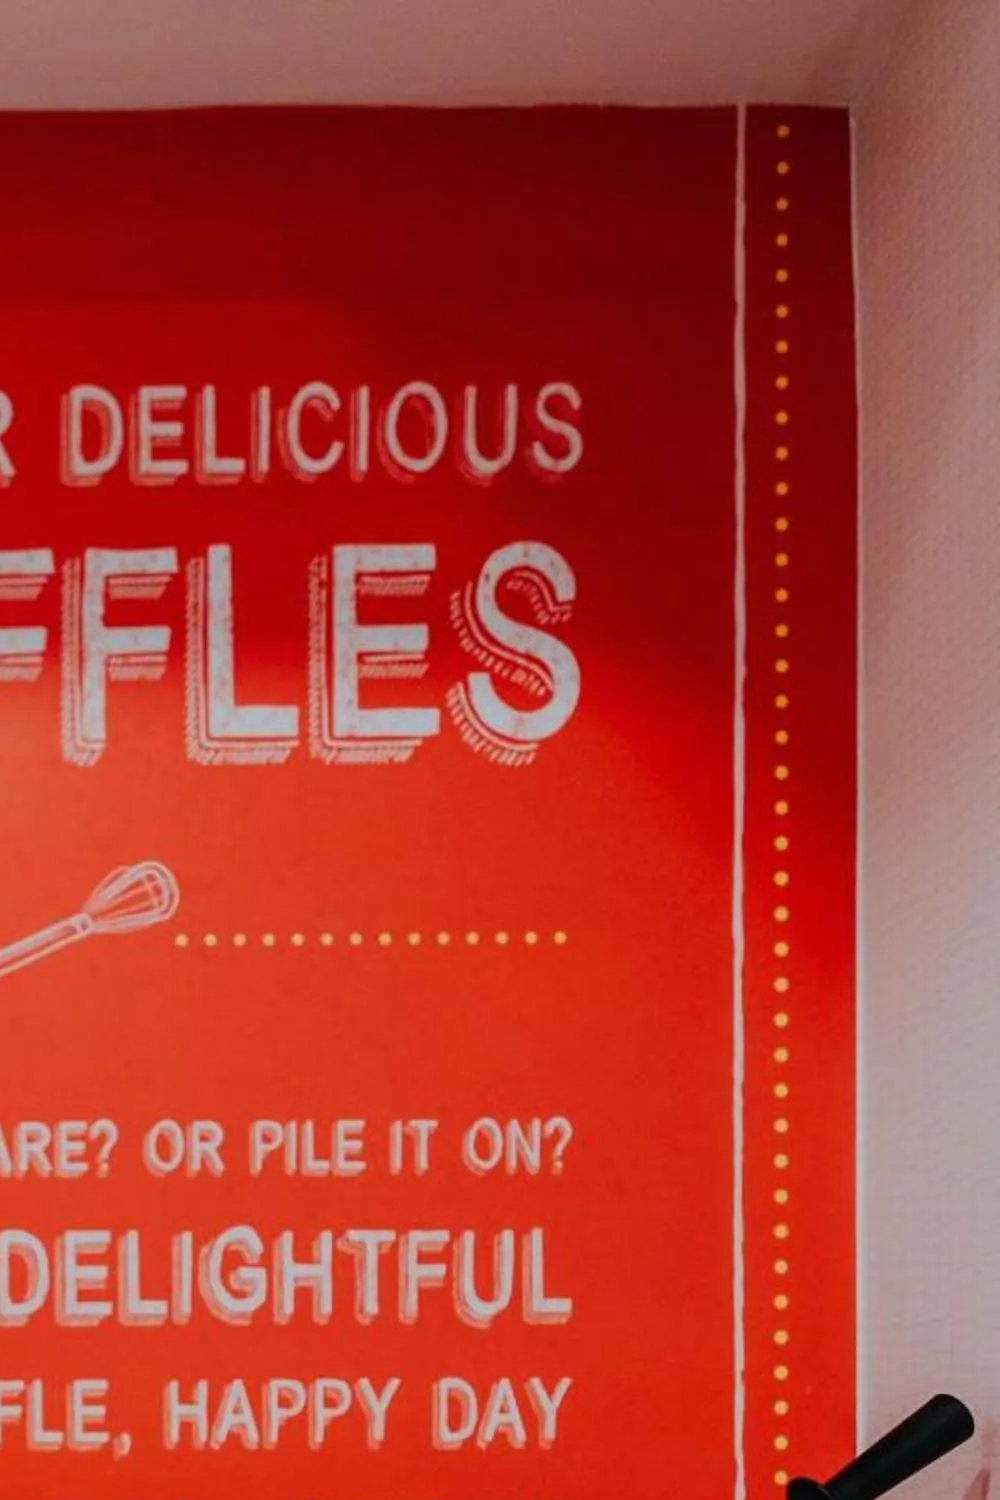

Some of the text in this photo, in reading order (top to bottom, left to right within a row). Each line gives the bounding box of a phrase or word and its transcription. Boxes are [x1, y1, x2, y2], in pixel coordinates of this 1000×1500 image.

[60, 381, 584, 487] DELICIOUS
[142, 1118, 224, 1177] OR
[248, 1118, 366, 1177] PILE
[388, 1118, 438, 1176] IT
[462, 1116, 573, 1175] ON?
[163, 1377, 401, 1451] HAPPY
[431, 1376, 573, 1449] DAY
